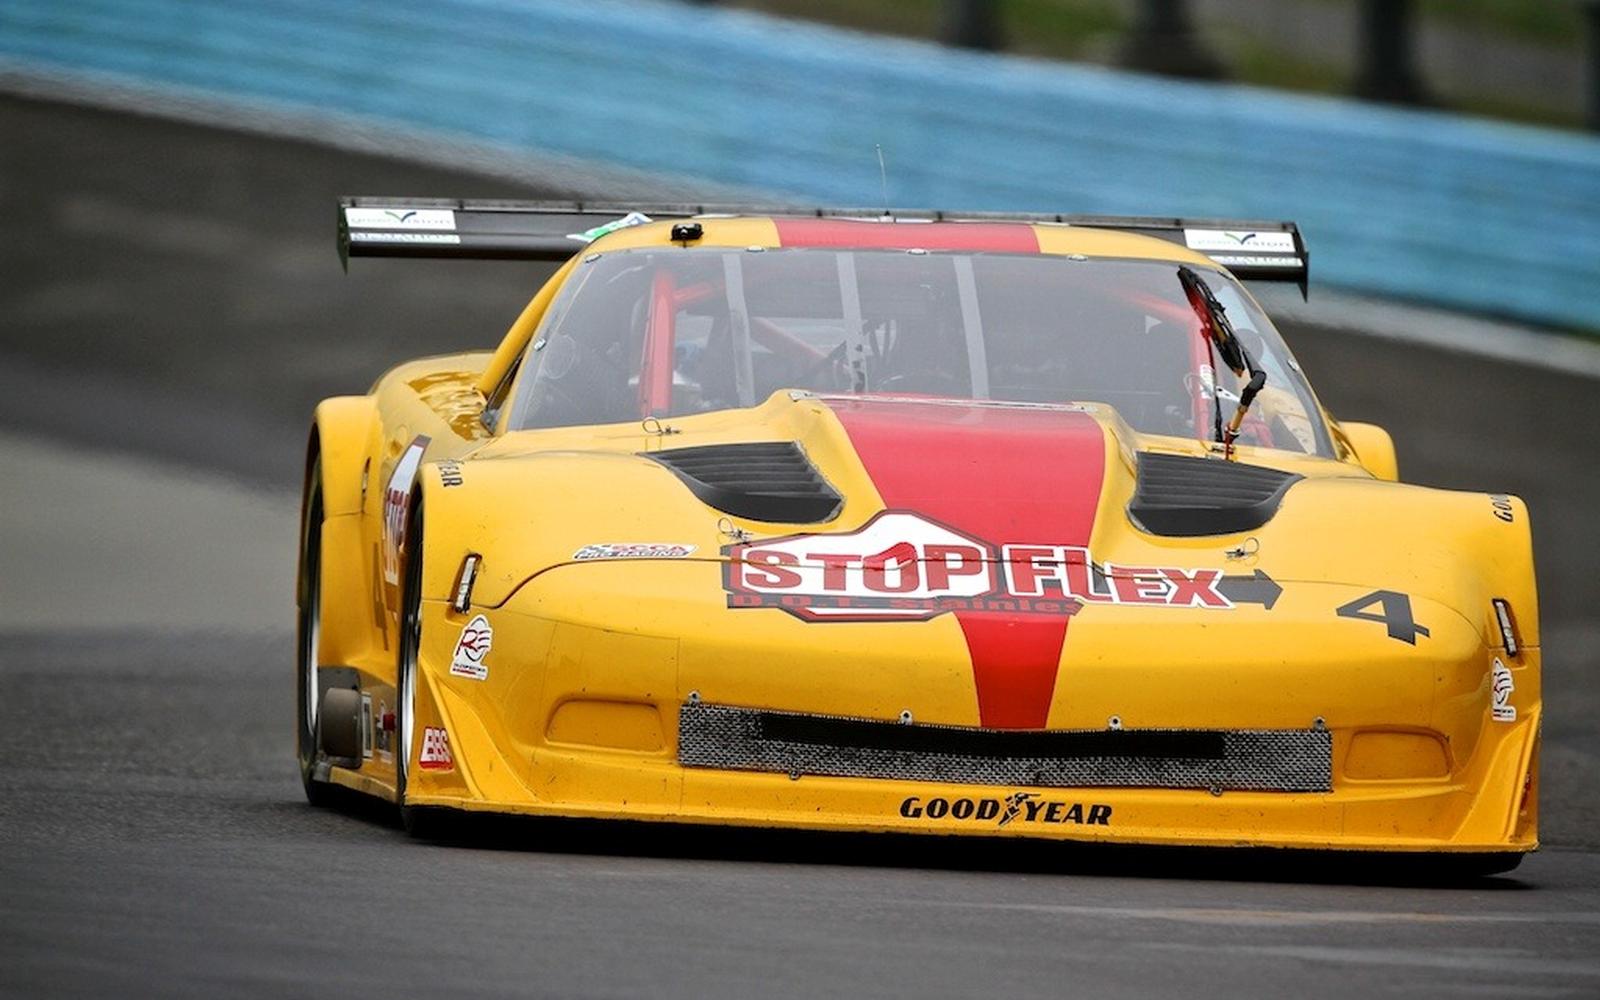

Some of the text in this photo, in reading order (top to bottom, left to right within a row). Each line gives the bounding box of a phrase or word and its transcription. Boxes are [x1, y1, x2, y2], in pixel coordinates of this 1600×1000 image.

[744, 541, 1236, 609] STOP FLEX
[1336, 589, 1431, 646] 4
